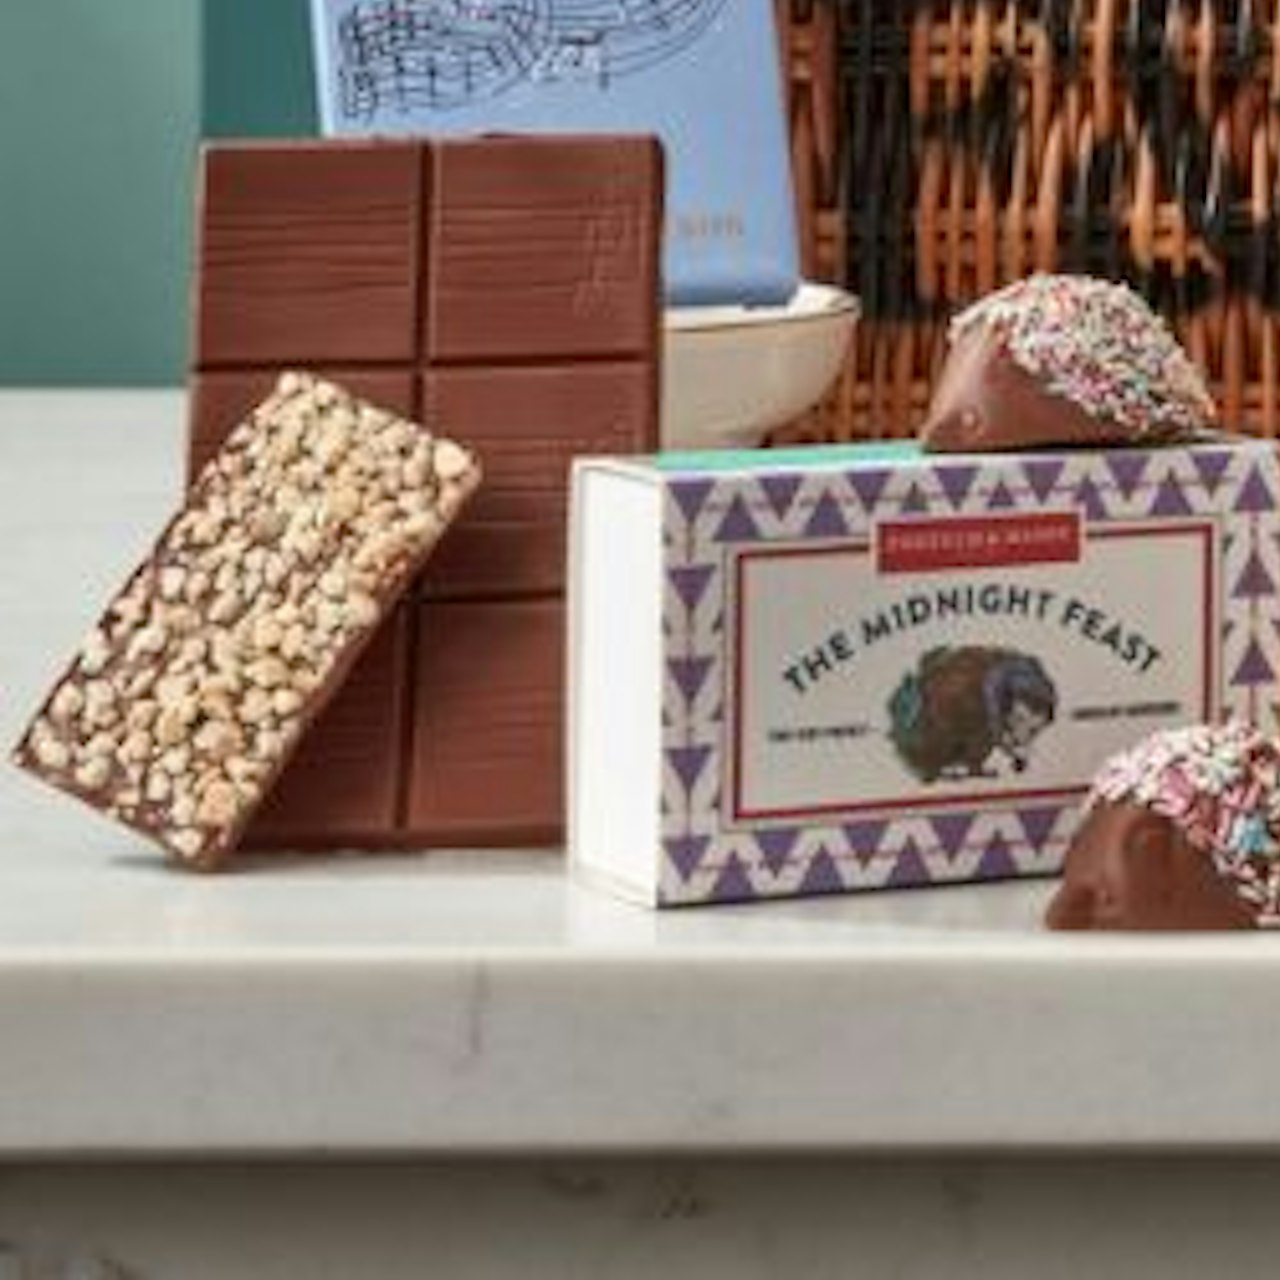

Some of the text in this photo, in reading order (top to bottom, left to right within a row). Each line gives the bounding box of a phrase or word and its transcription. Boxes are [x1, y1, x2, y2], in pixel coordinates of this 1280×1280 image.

[782, 584, 1162, 693] THE MIDNIGHT FEAST
